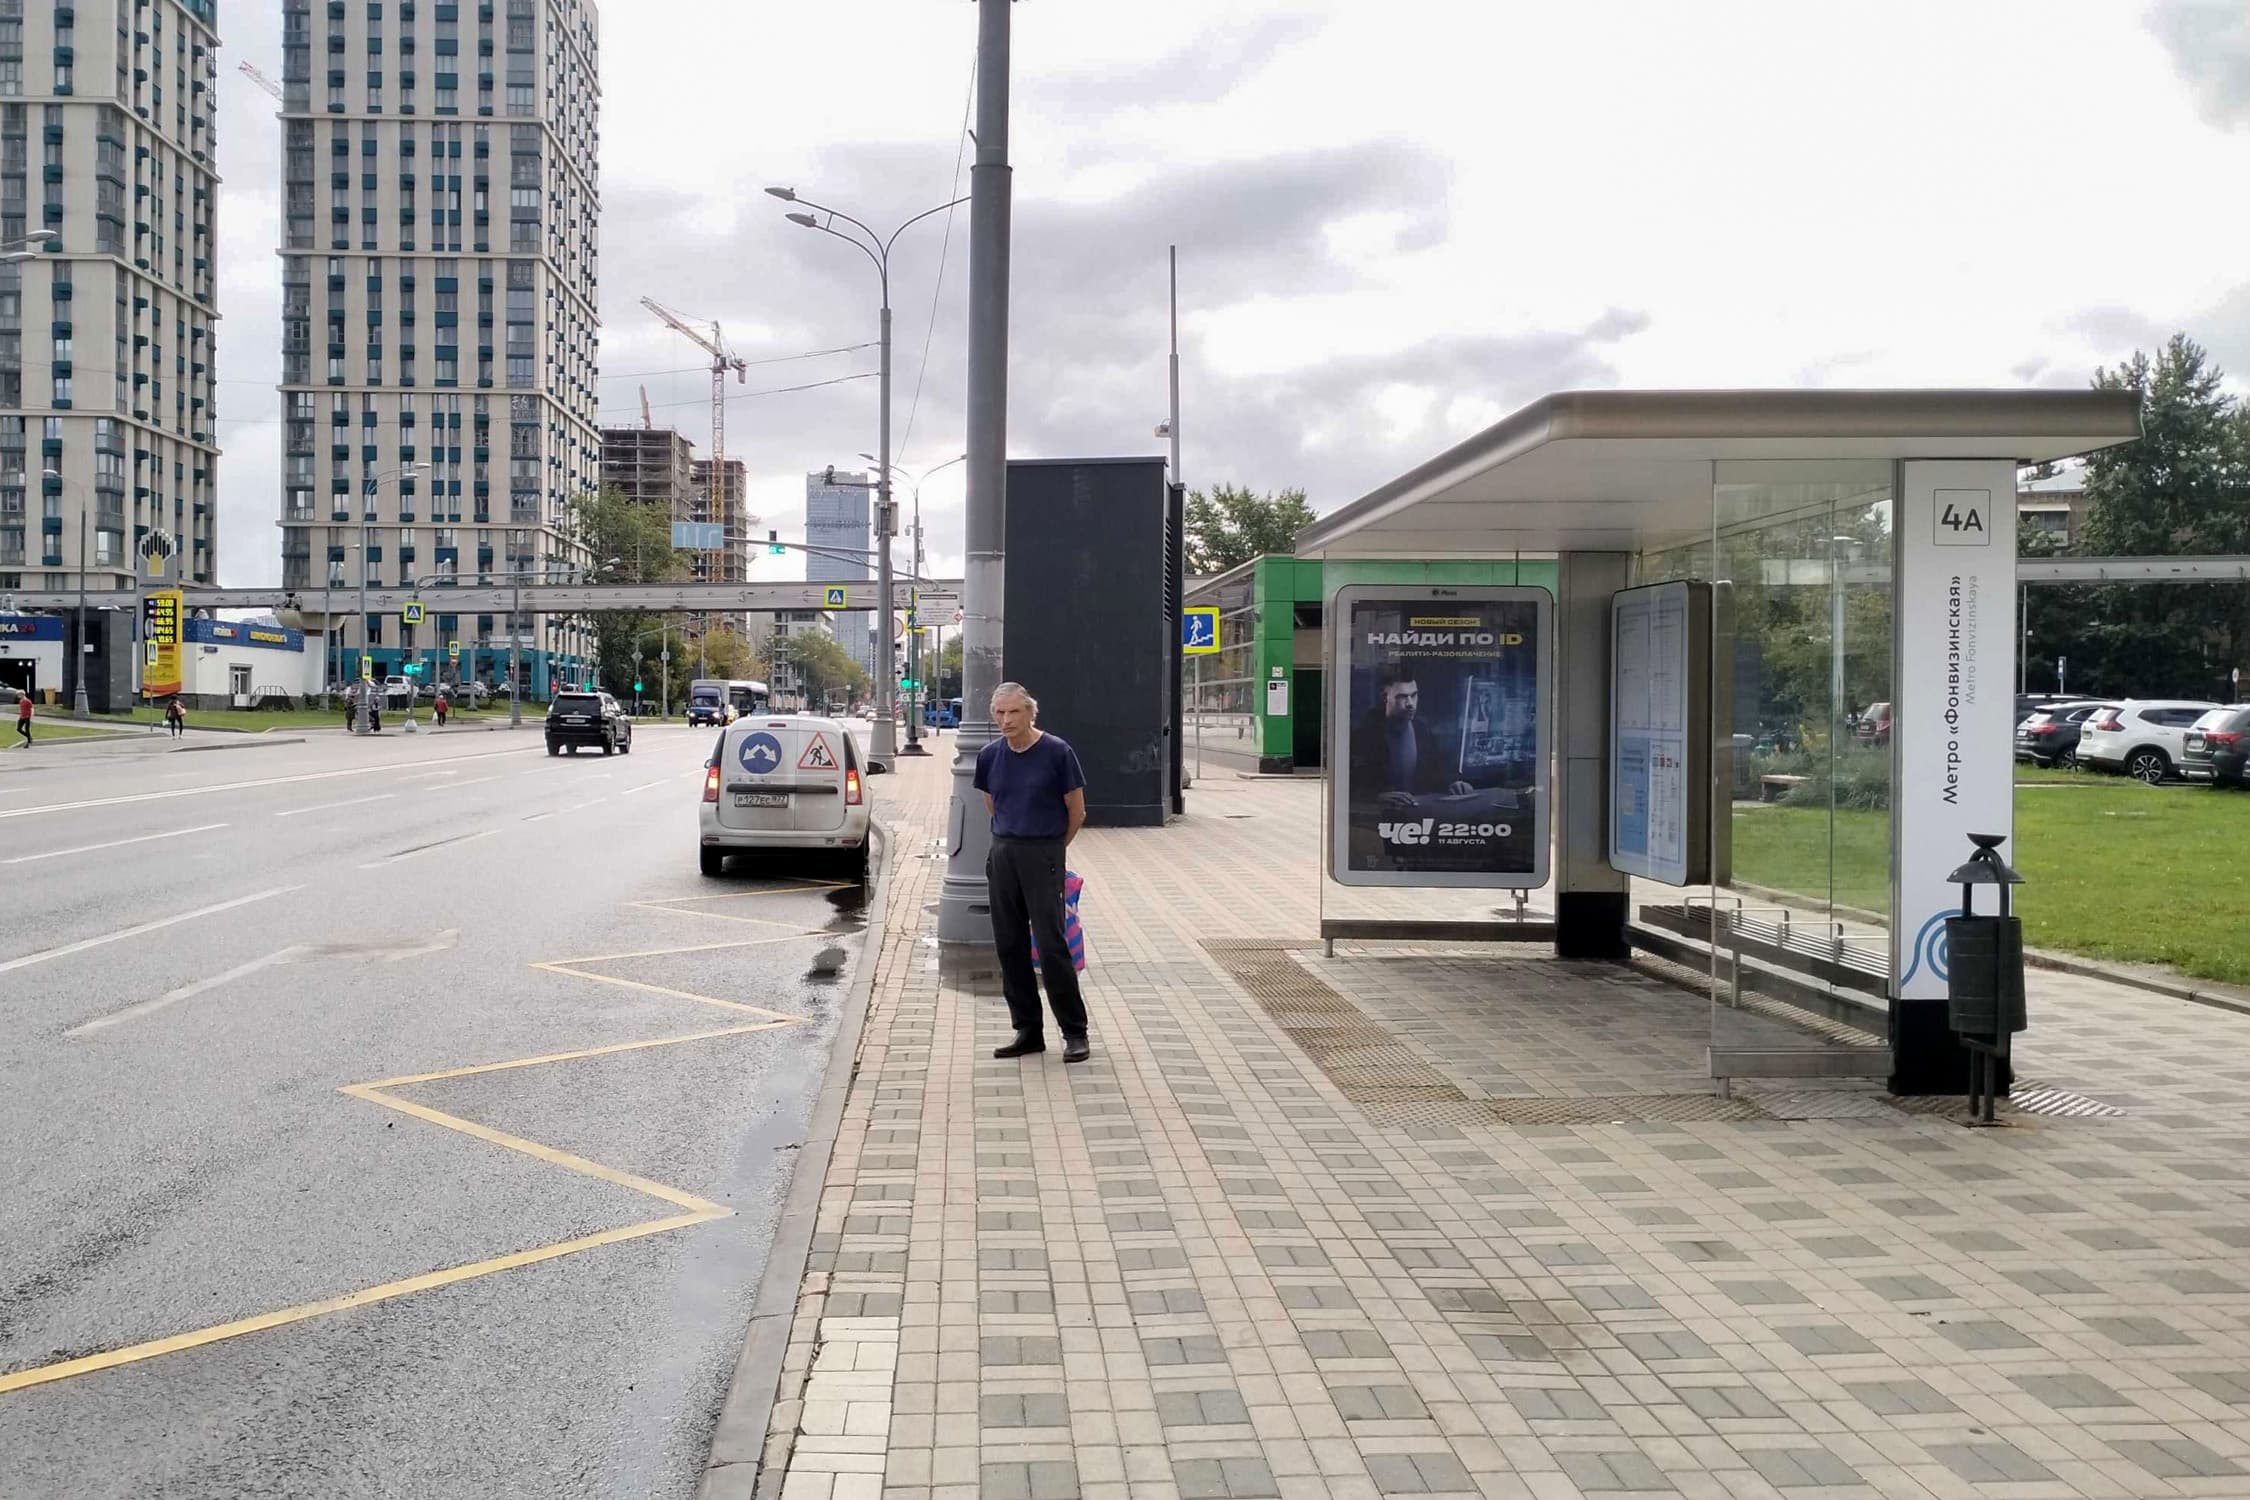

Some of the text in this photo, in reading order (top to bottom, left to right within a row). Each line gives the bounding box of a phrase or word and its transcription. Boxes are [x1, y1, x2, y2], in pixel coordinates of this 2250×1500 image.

[1941, 503, 1983, 532] 4А
[1414, 617, 1446, 625] НОВЫЙ
[1367, 630, 1524, 646] НАЙДИ ПО ID
[1965, 575, 1978, 705] Metro Fonvizinskaya
[1942, 575, 1961, 805] Метро «Фонвизинская»
[1437, 823, 1512, 837] 22:00
